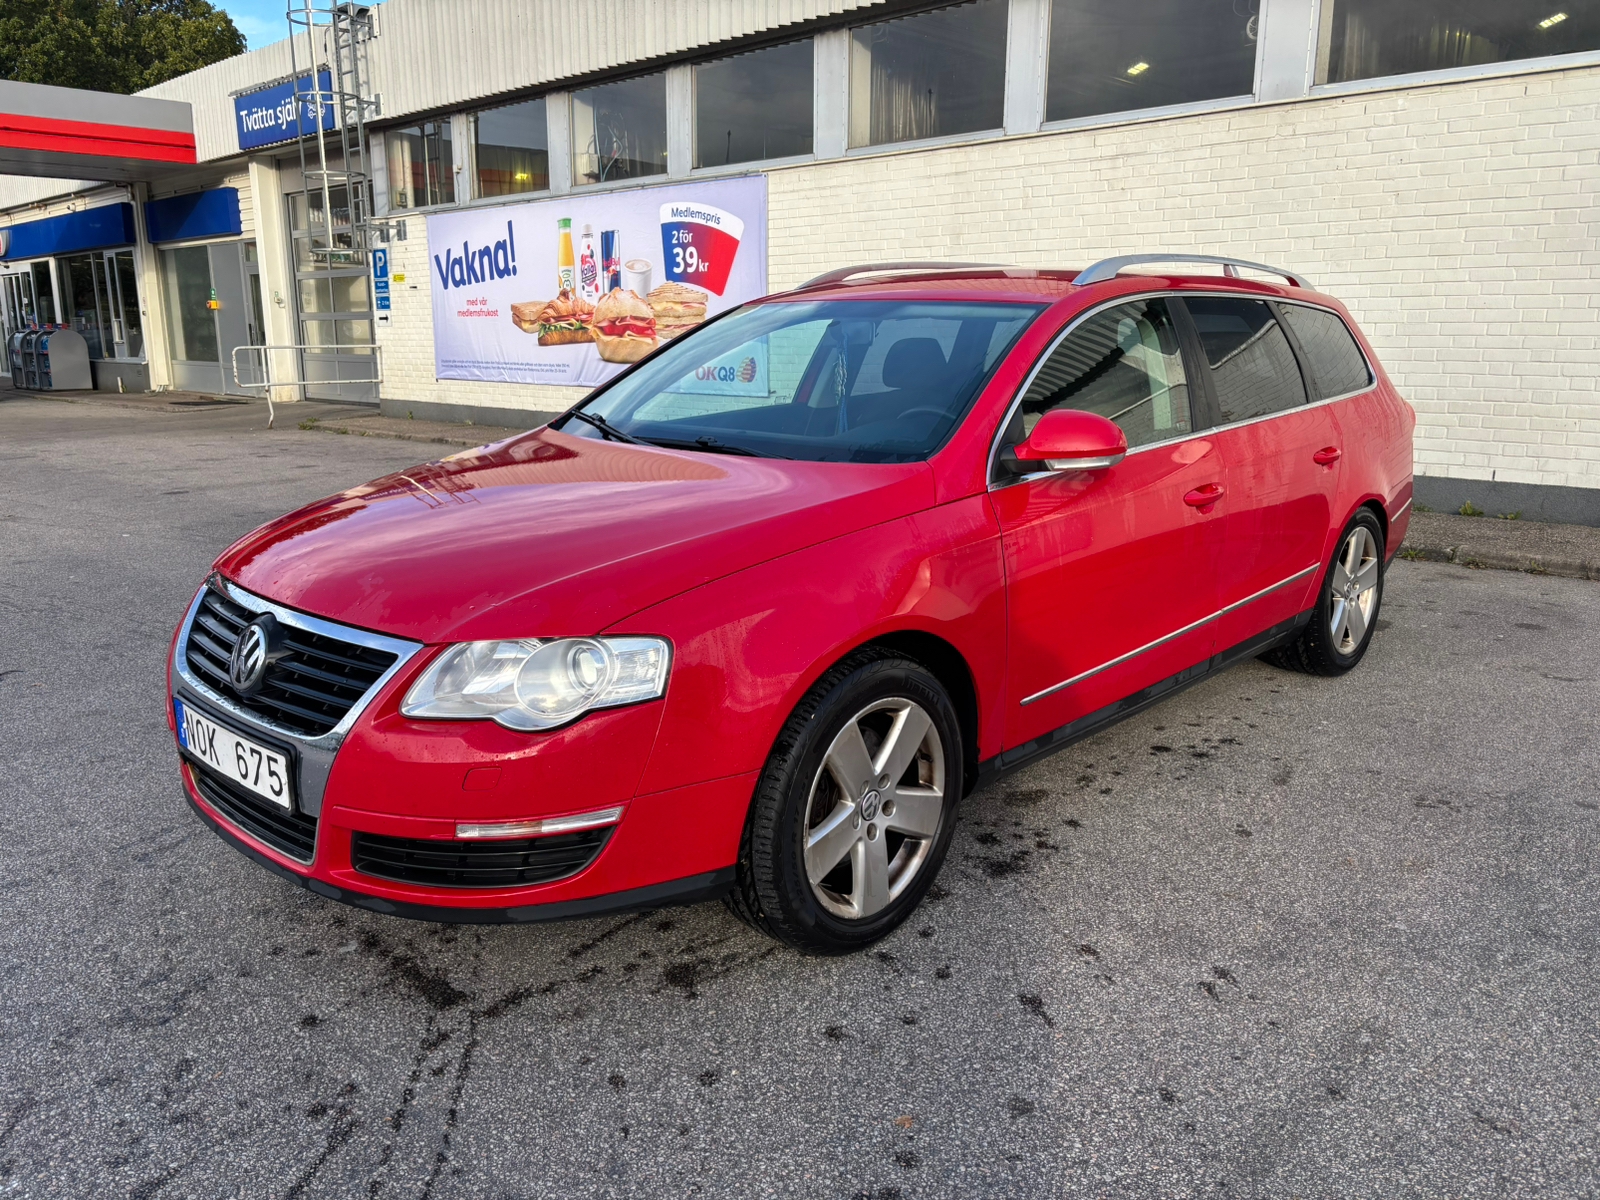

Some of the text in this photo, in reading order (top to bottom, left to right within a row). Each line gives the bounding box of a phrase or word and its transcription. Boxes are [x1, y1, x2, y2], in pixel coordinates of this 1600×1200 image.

[240, 107, 275, 132] Tvätta
[671, 207, 721, 225] Medlemspris
[671, 230, 693, 244] 2 för
[375, 251, 385, 276] P
[434, 220, 517, 290] Vakna!
[672, 246, 709, 274] 39 kr
[466, 296, 488, 306] med vår
[457, 308, 499, 317] medlemsfrukost
[695, 366, 736, 382] OKQ8
[185, 709, 284, 797] NOK 675
